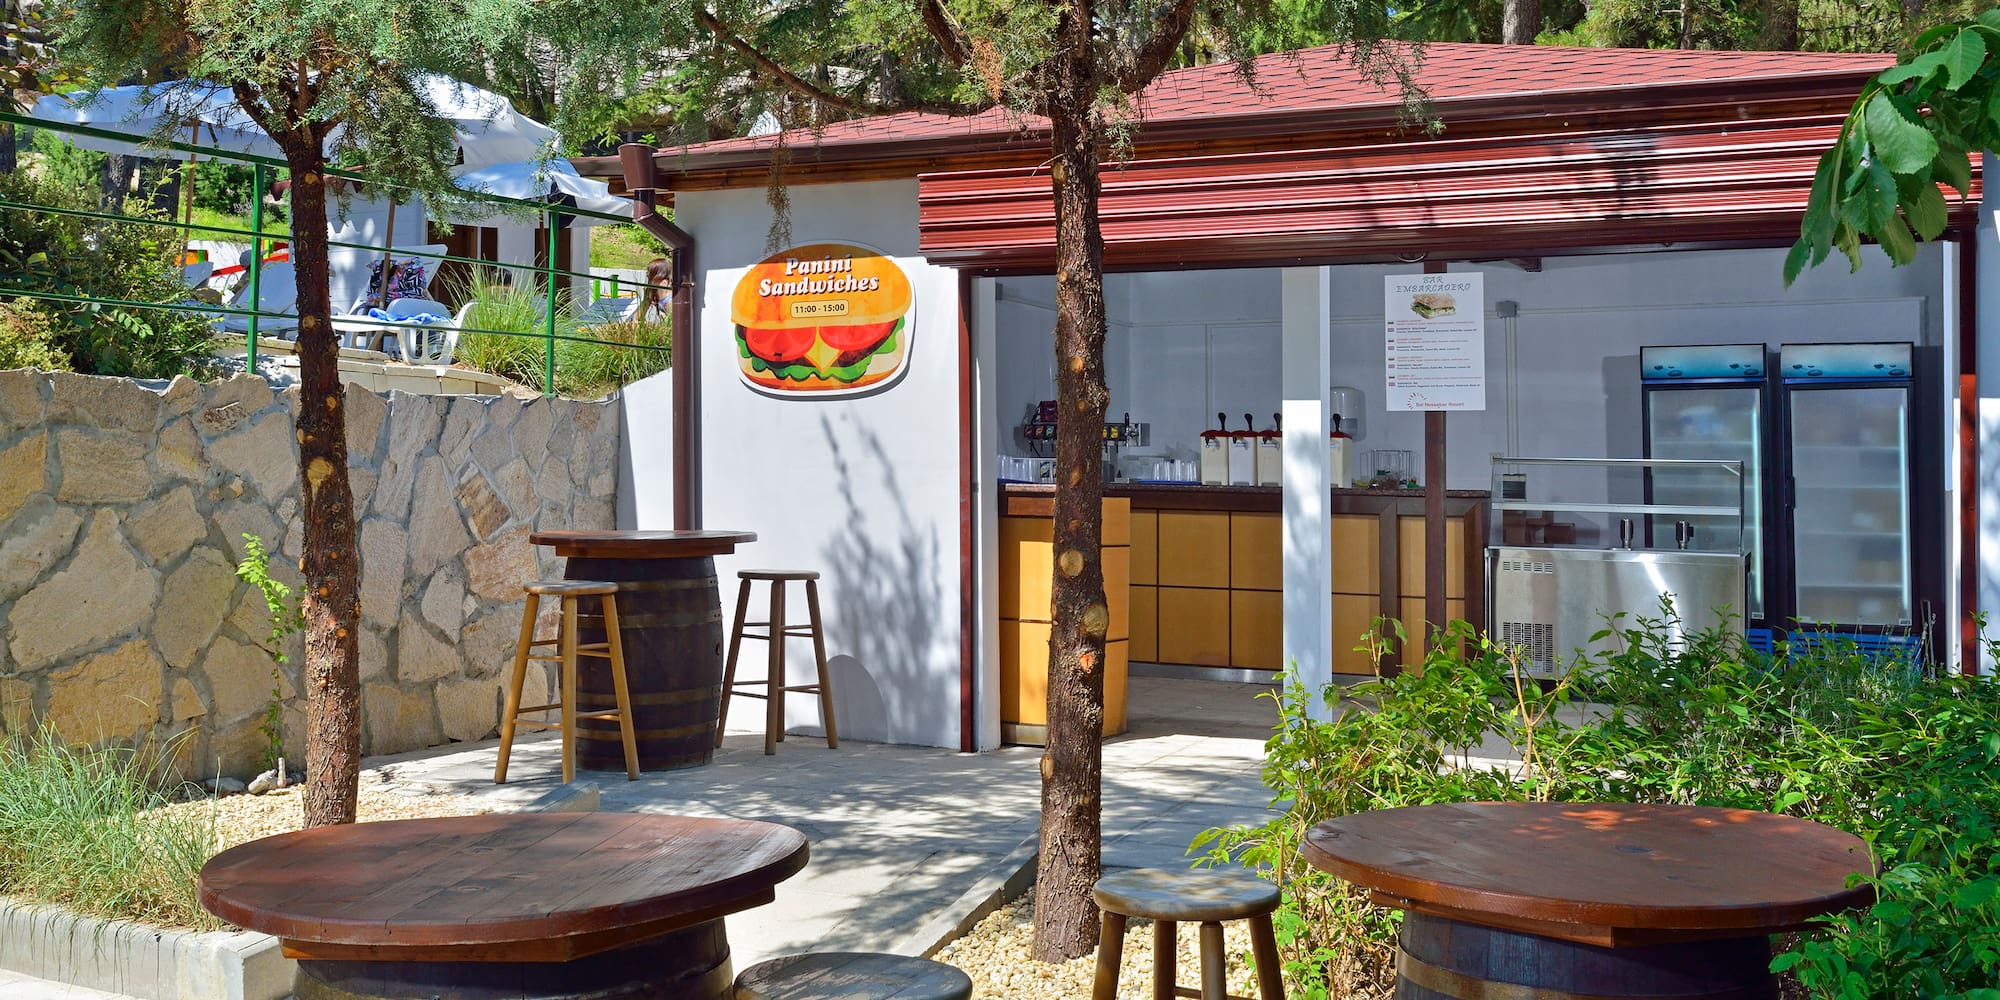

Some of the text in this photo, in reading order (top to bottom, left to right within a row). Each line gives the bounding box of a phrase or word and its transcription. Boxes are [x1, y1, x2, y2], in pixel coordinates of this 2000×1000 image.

[784, 255, 852, 276] Panini
[758, 274, 880, 297] Sandwiches
[1422, 276, 1444, 284] BAR
[794, 304, 817, 314] 11:00
[823, 303, 845, 313] 15:00
